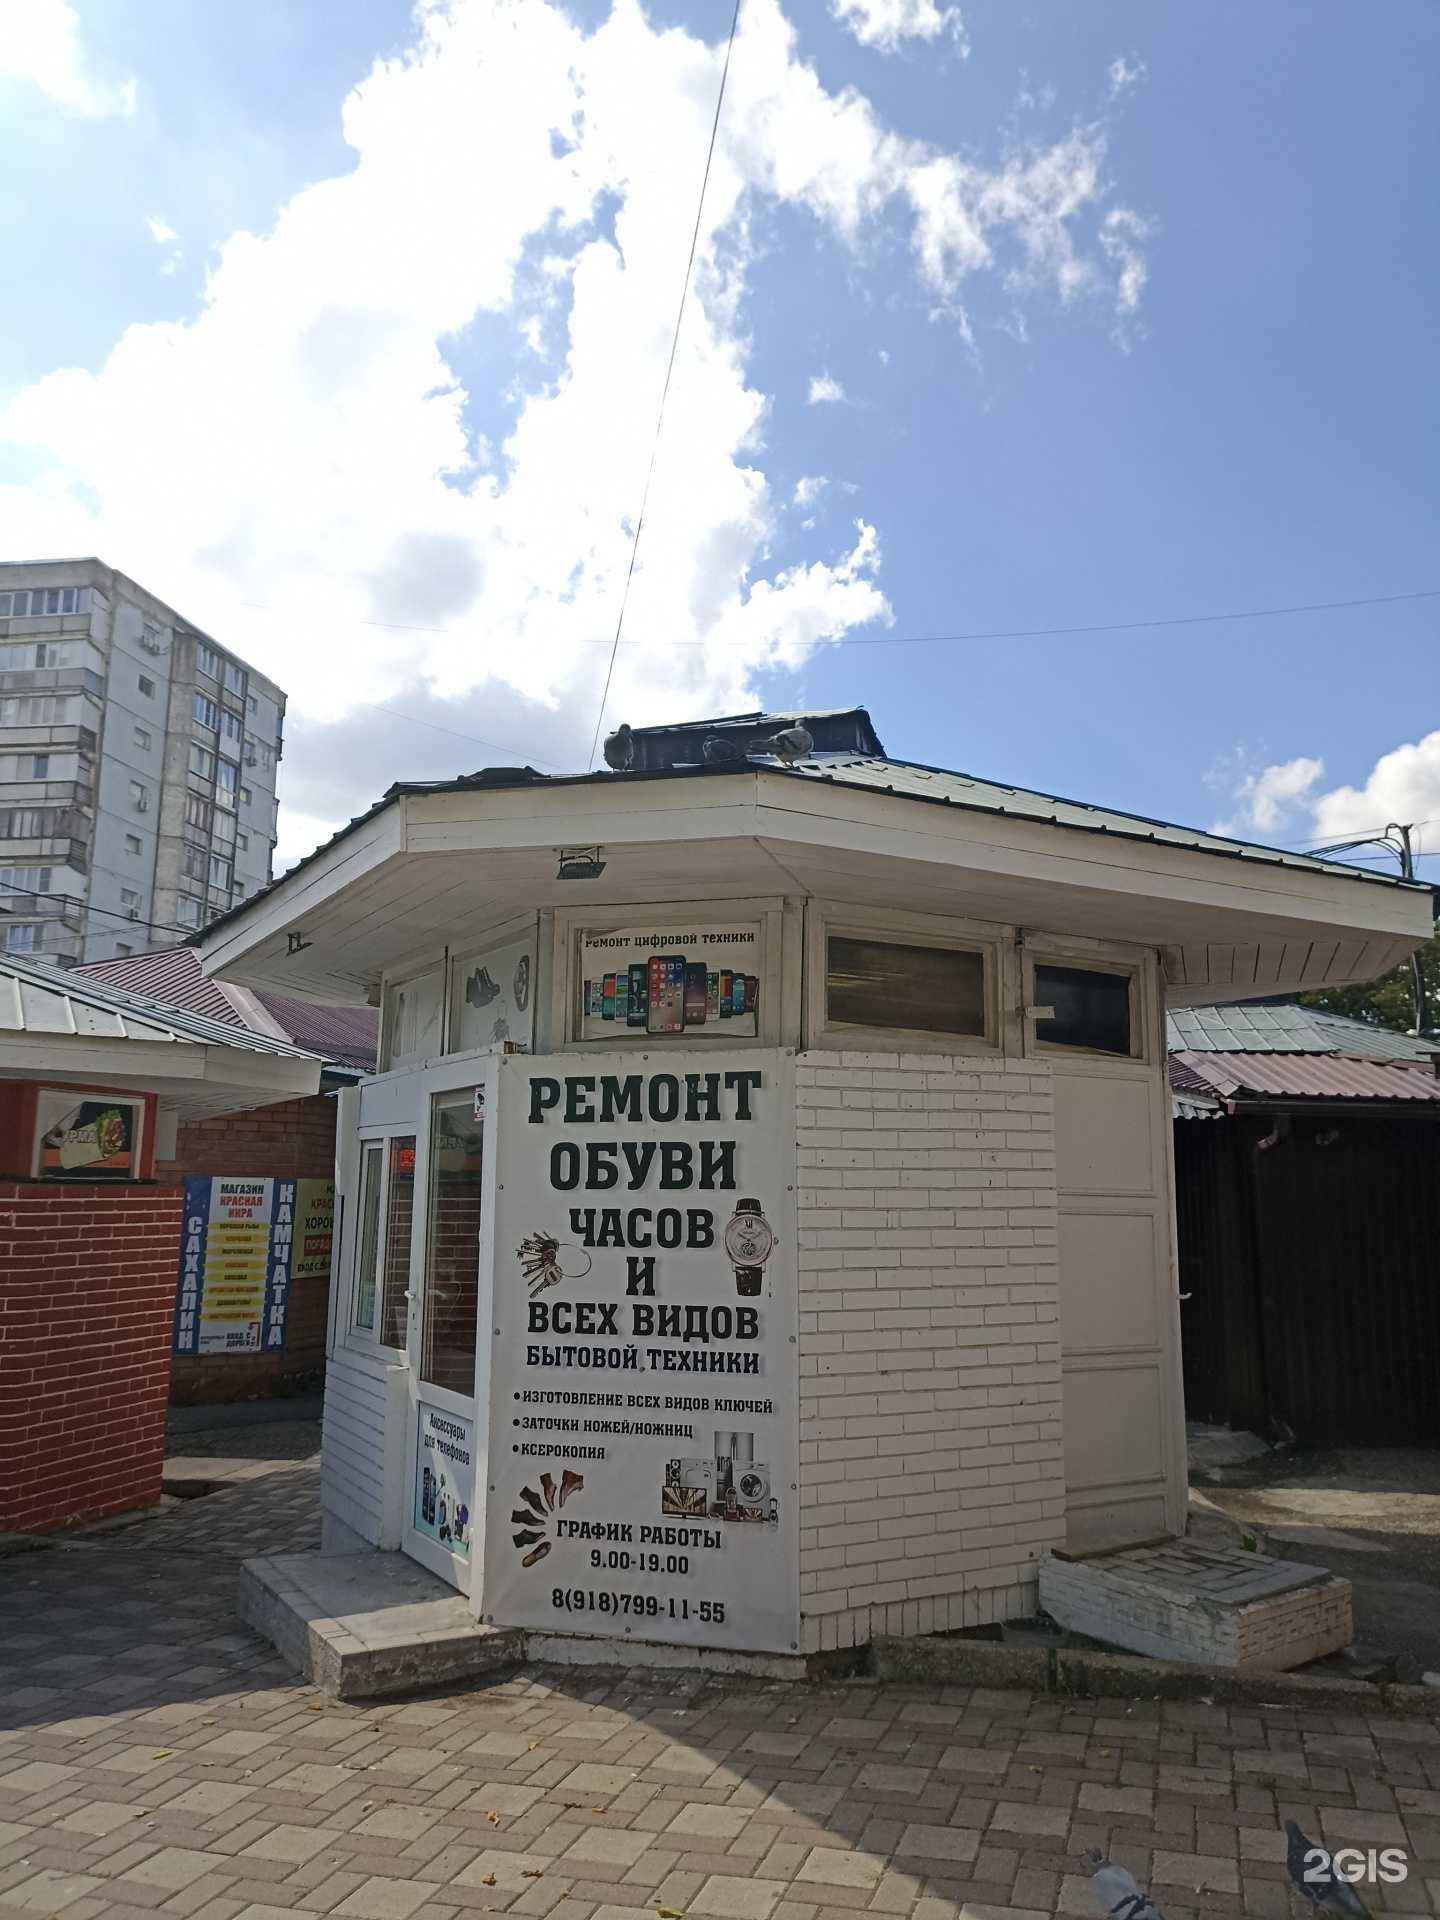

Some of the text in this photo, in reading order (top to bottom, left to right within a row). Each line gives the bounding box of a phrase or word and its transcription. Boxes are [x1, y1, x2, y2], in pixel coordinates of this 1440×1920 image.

[634, 933, 698, 948] цифровой
[701, 931, 755, 944] техники
[528, 1070, 763, 1124] РЕМОНТ
[549, 1140, 737, 1191] ОБУВИ
[219, 1195, 264, 1206] КРАСНАЯ
[220, 1183, 265, 1195] МАГАЗИН
[227, 1208, 253, 1218] ИКРА
[568, 1207, 715, 1248] ЧАСОВ
[268, 1184, 294, 1346] КАМЧАТКА
[625, 1256, 656, 1297] И
[178, 1216, 203, 1349] САХАЛИН
[527, 1301, 759, 1344] ВСЕХ ВИДОВ
[525, 1343, 760, 1375] БЫТОВОЙ ТЕХНИКИ
[522, 1390, 774, 1414] ИЗГОТОВЛЕНИЕ ВСЕХ ВИДОВ КЛЮЧЕЙ
[430, 1413, 466, 1441] Аксессуары
[521, 1416, 694, 1439] ЗАТОЧКИ НОЖЕЙ/НОЖНИЦ
[424, 1434, 470, 1465] для телефонов
[521, 1443, 606, 1460] КСЕРОКОПИЯ
[556, 1519, 722, 1549] ГРАФИК РАБОТЫ
[589, 1549, 689, 1574] 9.00-19.00
[551, 1588, 725, 1624] 8(918)799-11-55
